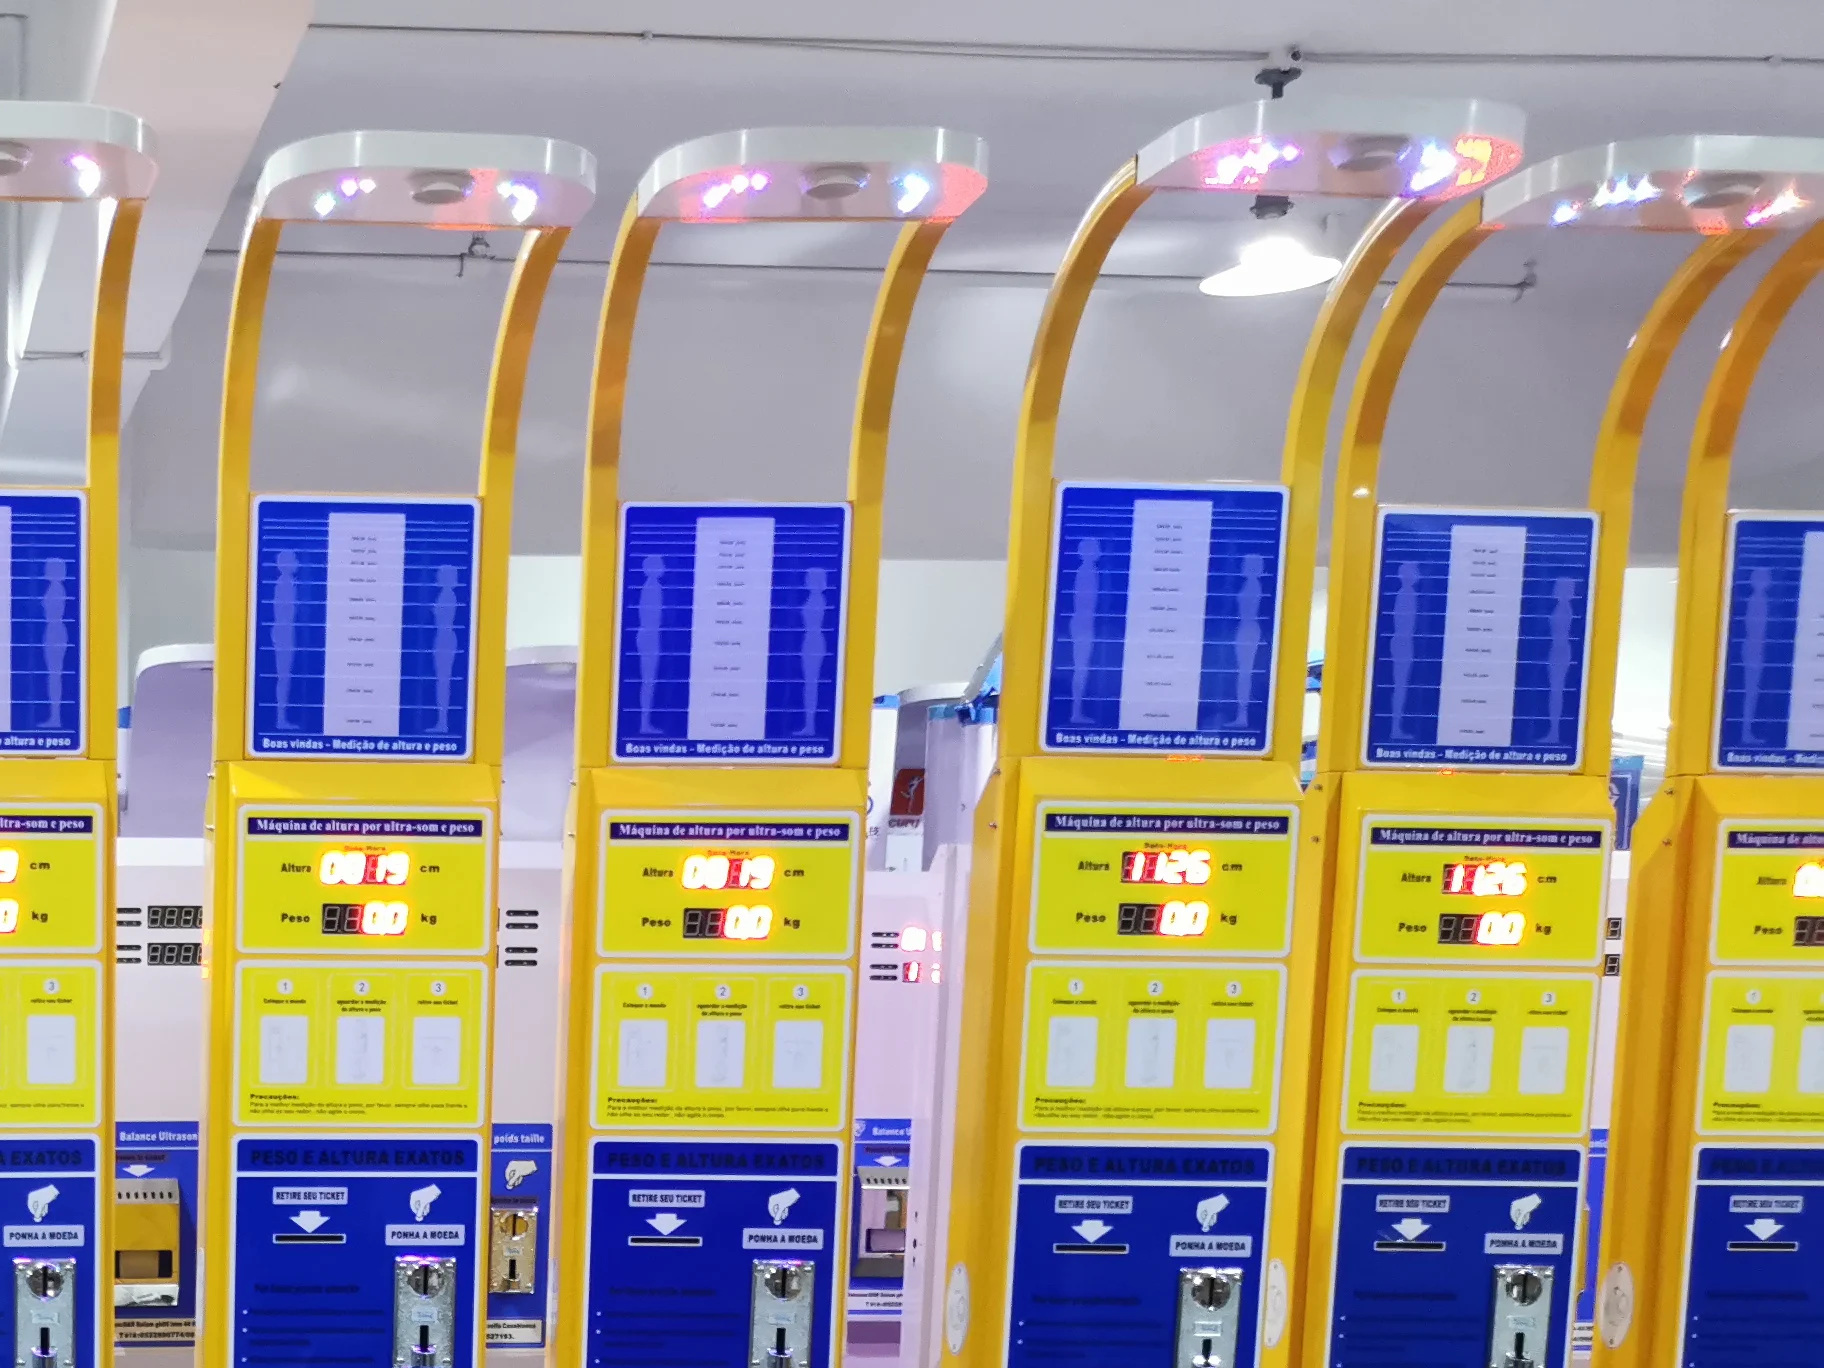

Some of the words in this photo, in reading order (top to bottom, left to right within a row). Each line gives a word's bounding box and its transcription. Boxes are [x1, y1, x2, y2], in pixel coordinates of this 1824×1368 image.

[290, 738, 323, 749] vindas
[332, 739, 375, 751] Medição
[377, 739, 389, 750] de
[391, 739, 422, 751] altura
[432, 743, 457, 752] peso
[59, 821, 84, 832] peso
[619, 824, 670, 838] Máquina
[672, 824, 685, 836] de
[688, 825, 723, 836] altura
[725, 828, 744, 838] por
[748, 825, 803, 836] ultra-som
[814, 828, 840, 839] peso
[280, 863, 311, 873] Altura
[1077, 861, 1110, 871] Altura
[1221, 863, 1243, 871] cm
[642, 868, 673, 877] Altura
[31, 911, 48, 923] kg
[280, 913, 310, 923] Peso
[420, 913, 437, 925] kg
[641, 917, 671, 927] Peso
[1075, 912, 1106, 923] Peso
[1220, 913, 1238, 925] kg
[783, 918, 801, 929] kg
[1397, 922, 1427, 932] Peso
[1535, 924, 1552, 935] kg
[119, 1131, 157, 1142] Balance
[494, 1133, 519, 1145] poids
[520, 1133, 545, 1143] taille
[275, 1191, 301, 1200] RETIRE
[302, 1191, 317, 1200] SEU
[319, 1191, 344, 1200] TICKET
[391, 1231, 420, 1239] PONHA
[422, 1231, 428, 1239] A
[429, 1231, 459, 1239] MOEDA
[1175, 1241, 1206, 1250] PONHA
[1207, 1242, 1213, 1250] A
[1215, 1242, 1246, 1251] MOEDA
